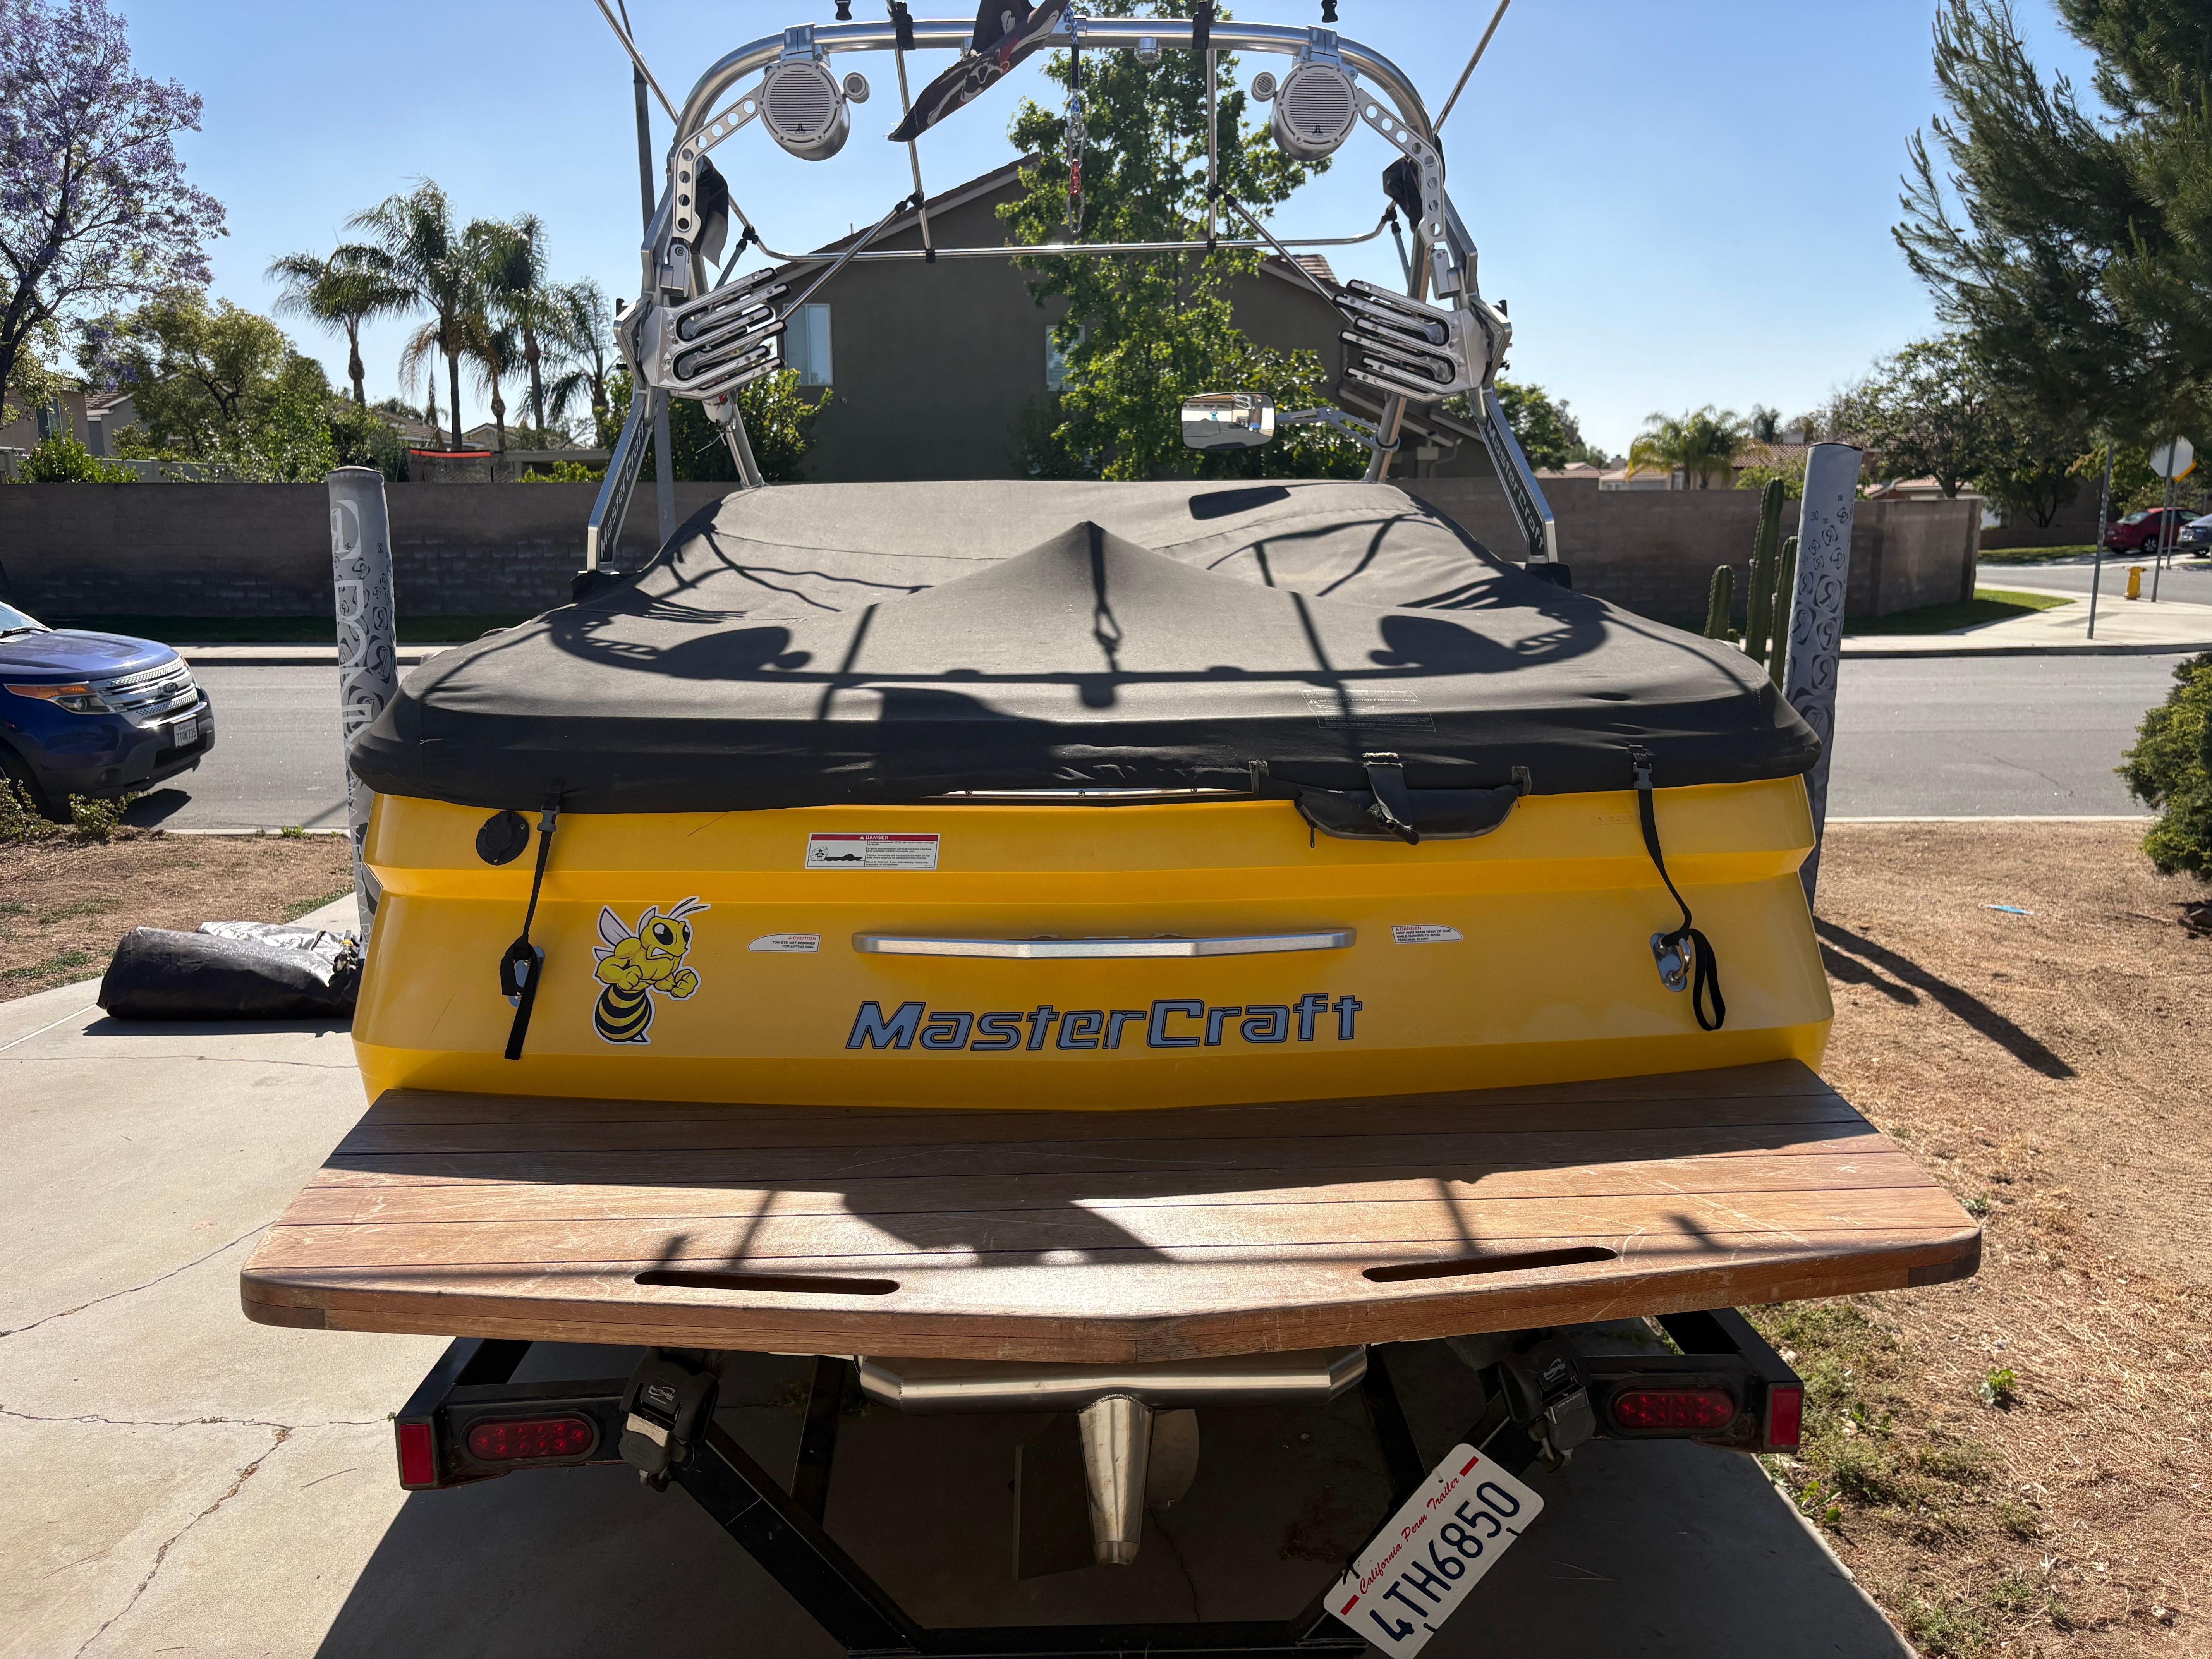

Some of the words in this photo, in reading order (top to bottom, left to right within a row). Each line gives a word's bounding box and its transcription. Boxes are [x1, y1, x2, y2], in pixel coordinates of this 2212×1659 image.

[1487, 420, 1544, 550] MasterCraft
[845, 993, 1363, 1051] MasterCraft
[1359, 1543, 1403, 1595] California
[1401, 1514, 1428, 1542] Perm
[1426, 1477, 1460, 1510] Trailer
[1369, 1481, 1521, 1642] 4TH6850
